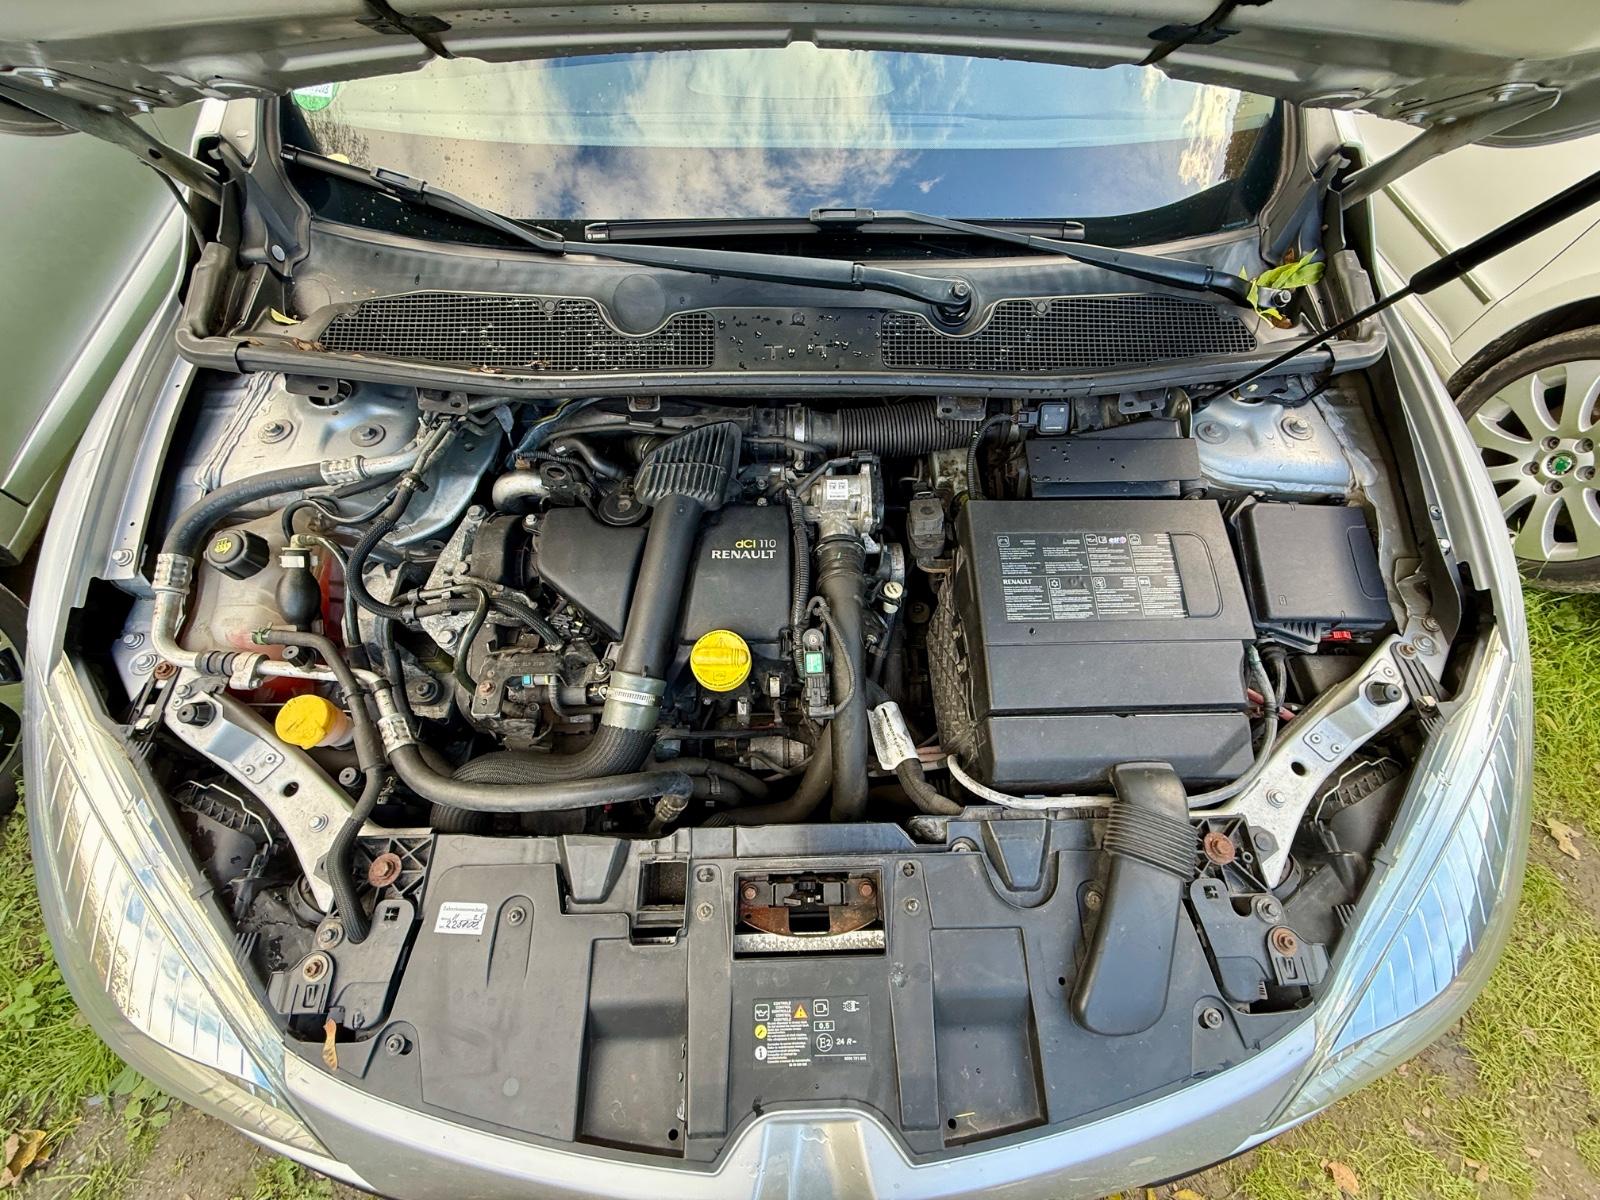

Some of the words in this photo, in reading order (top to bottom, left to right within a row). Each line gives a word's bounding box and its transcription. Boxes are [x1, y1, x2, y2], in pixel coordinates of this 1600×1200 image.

[759, 539, 777, 548] 110
[711, 550, 777, 559] RENAULT
[818, 1022, 830, 1030] 0,5
[819, 1037, 832, 1049] E2
[836, 1038, 845, 1046] 24
